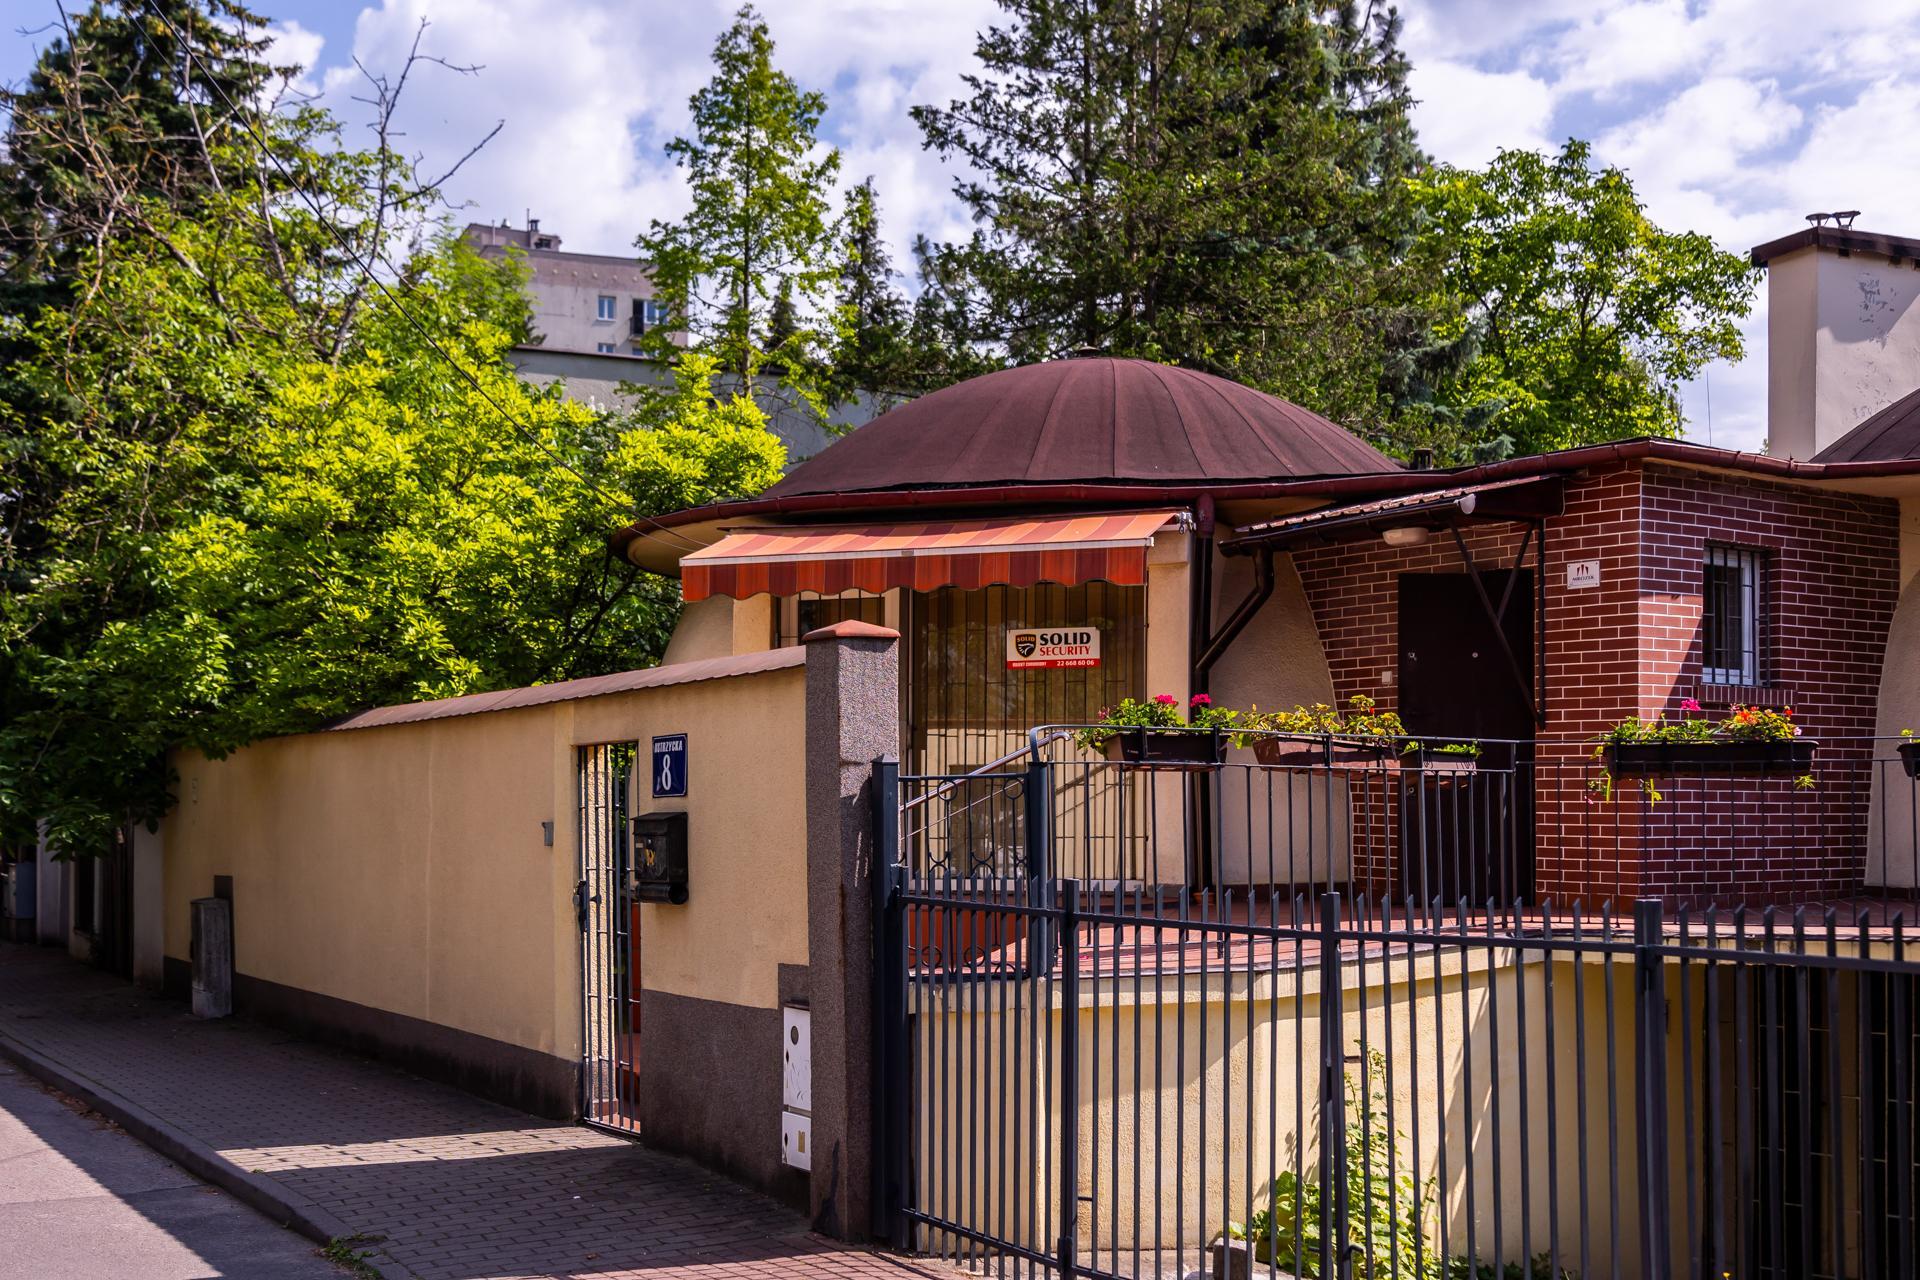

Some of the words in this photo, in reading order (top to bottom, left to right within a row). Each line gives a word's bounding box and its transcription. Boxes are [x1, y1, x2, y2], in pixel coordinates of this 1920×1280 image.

[1040, 632, 1091, 646] SOLID
[1040, 646, 1091, 656] SECURITY
[662, 754, 671, 790] 8
